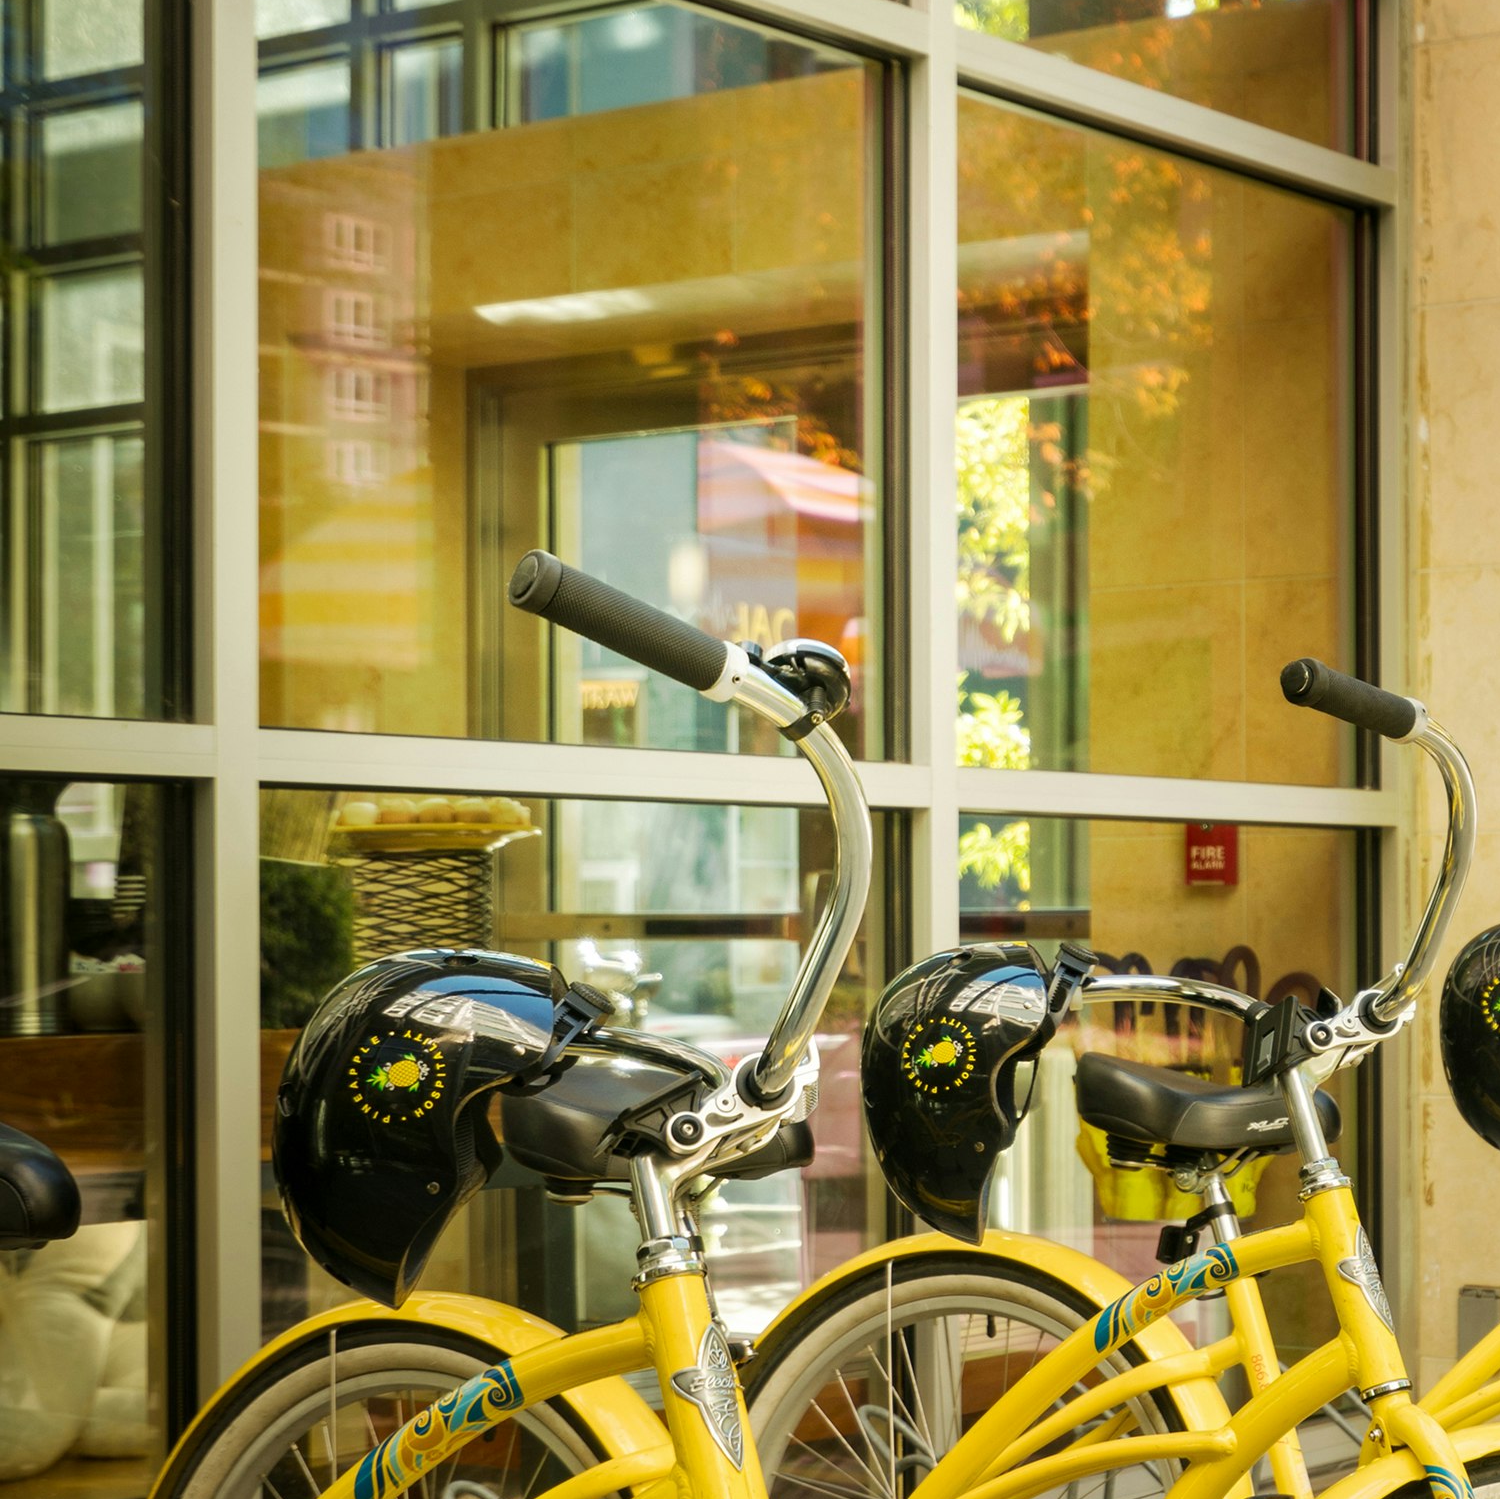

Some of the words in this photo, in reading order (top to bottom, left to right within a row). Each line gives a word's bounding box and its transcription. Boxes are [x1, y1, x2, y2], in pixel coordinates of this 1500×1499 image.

[1191, 846, 1225, 860] FIRE
[1191, 861, 1225, 870] ALARM
[349, 1036, 391, 1123] PINEAPPLE
[403, 1030, 446, 1118] HOSPITALITY
[903, 1024, 938, 1094] PINEAPPLE
[940, 1017, 977, 1087] HOSPITALITY
